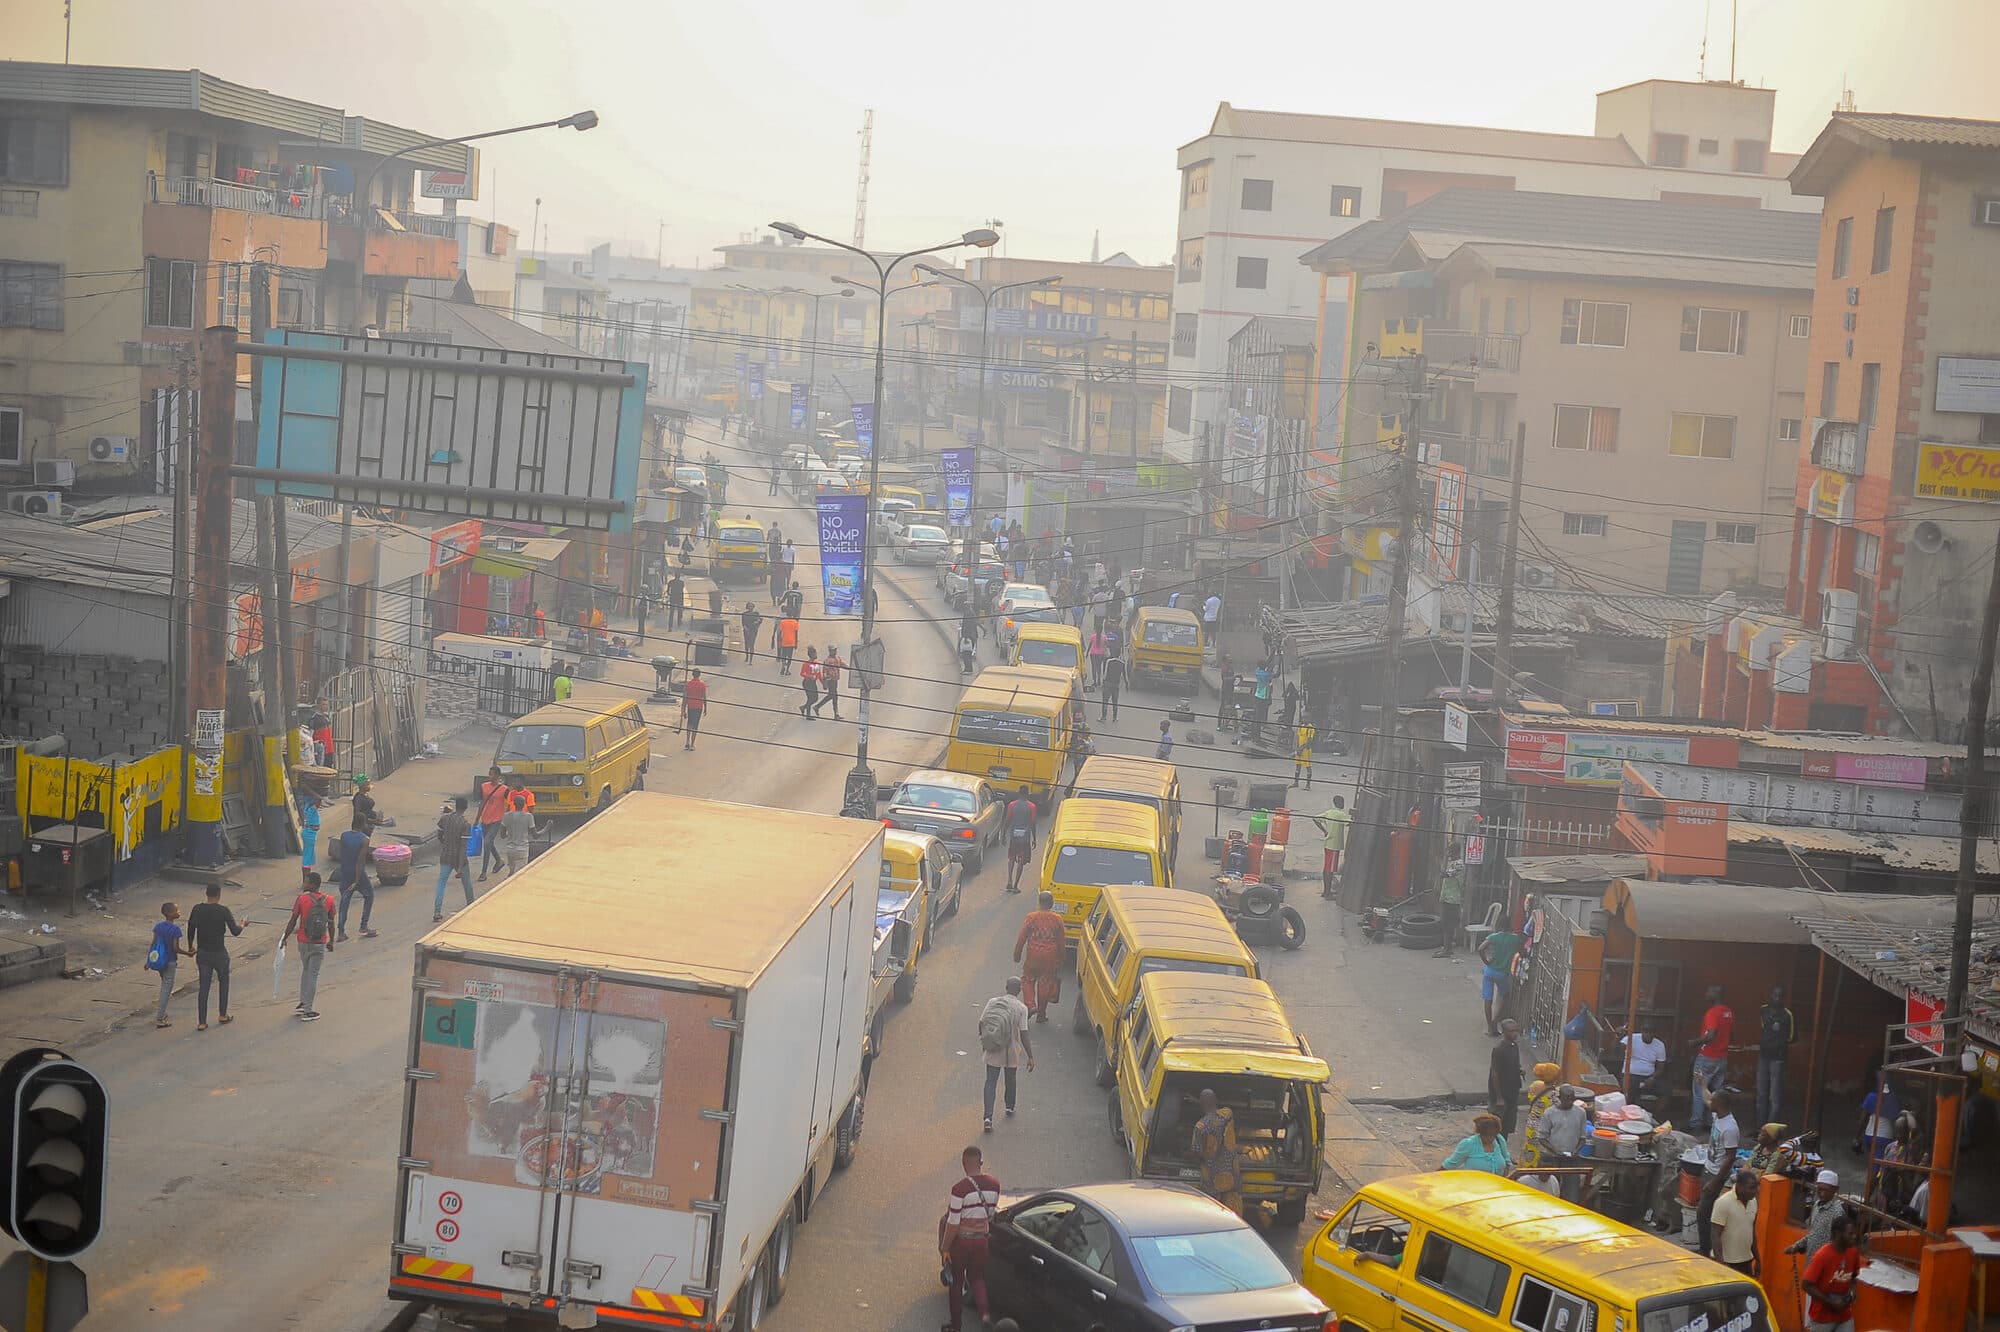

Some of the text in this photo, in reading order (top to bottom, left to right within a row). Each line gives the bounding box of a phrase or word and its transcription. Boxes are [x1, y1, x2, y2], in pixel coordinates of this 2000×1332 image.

[426, 184, 466, 194] ZENITH
[945, 461, 960, 469] NO
[822, 516, 843, 528] NO
[822, 529, 860, 541] DAMP
[823, 541, 862, 553] SMELL
[1509, 732, 1549, 743] SanDisk
[1678, 806, 1717, 818] SPORTS
[446, 1196, 458, 1208] 70
[442, 1224, 455, 1236] 80
